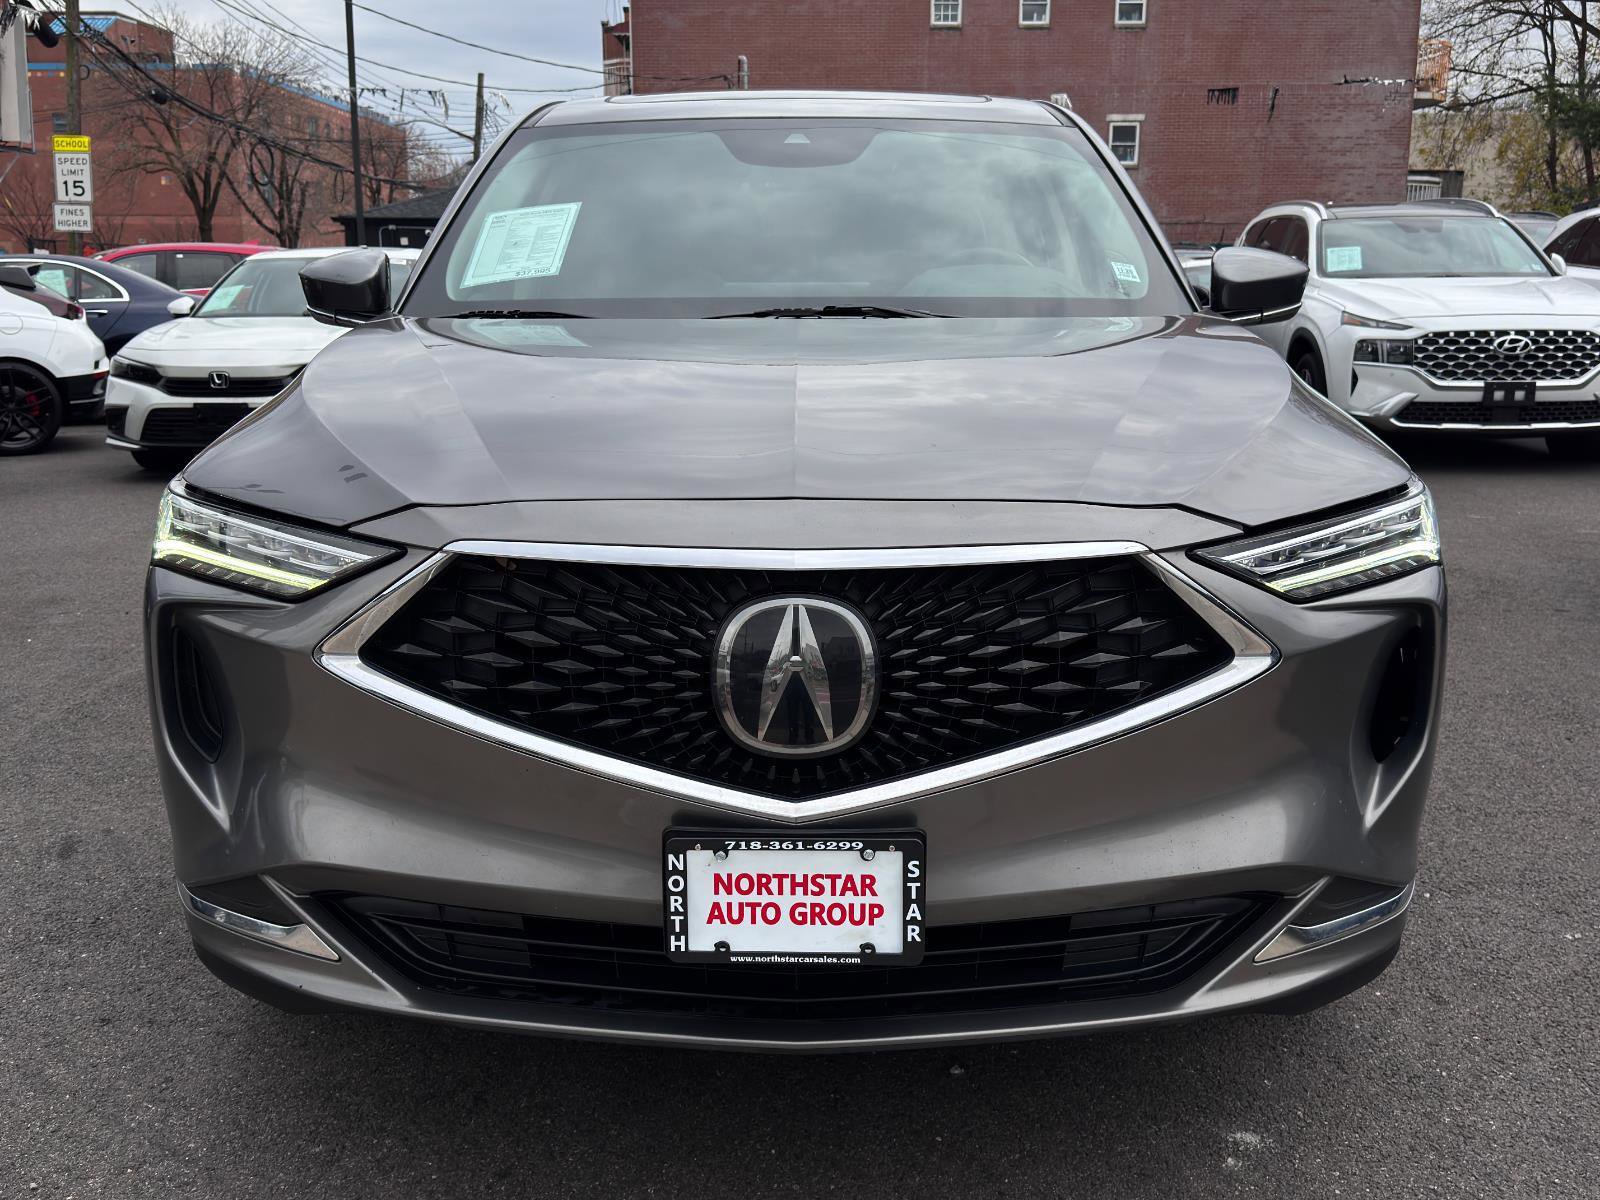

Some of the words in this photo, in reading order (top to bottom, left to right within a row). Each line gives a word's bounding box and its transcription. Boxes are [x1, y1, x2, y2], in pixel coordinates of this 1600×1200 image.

[55, 140, 87, 148] SCHOOL
[57, 157, 88, 166] SPEED
[61, 168, 84, 177] LIMIT
[62, 180, 86, 197] 15
[60, 208, 85, 217] FINES
[57, 219, 88, 228] HIGHER
[724, 840, 864, 851] 718-361-6299
[713, 872, 879, 897] NORTHSTAR
[667, 853, 686, 952] NORTH
[905, 860, 923, 943] STAR
[706, 902, 782, 926] AUTO
[789, 902, 885, 927] GROUP
[729, 954, 862, 965] www.northstarcarsales.com
